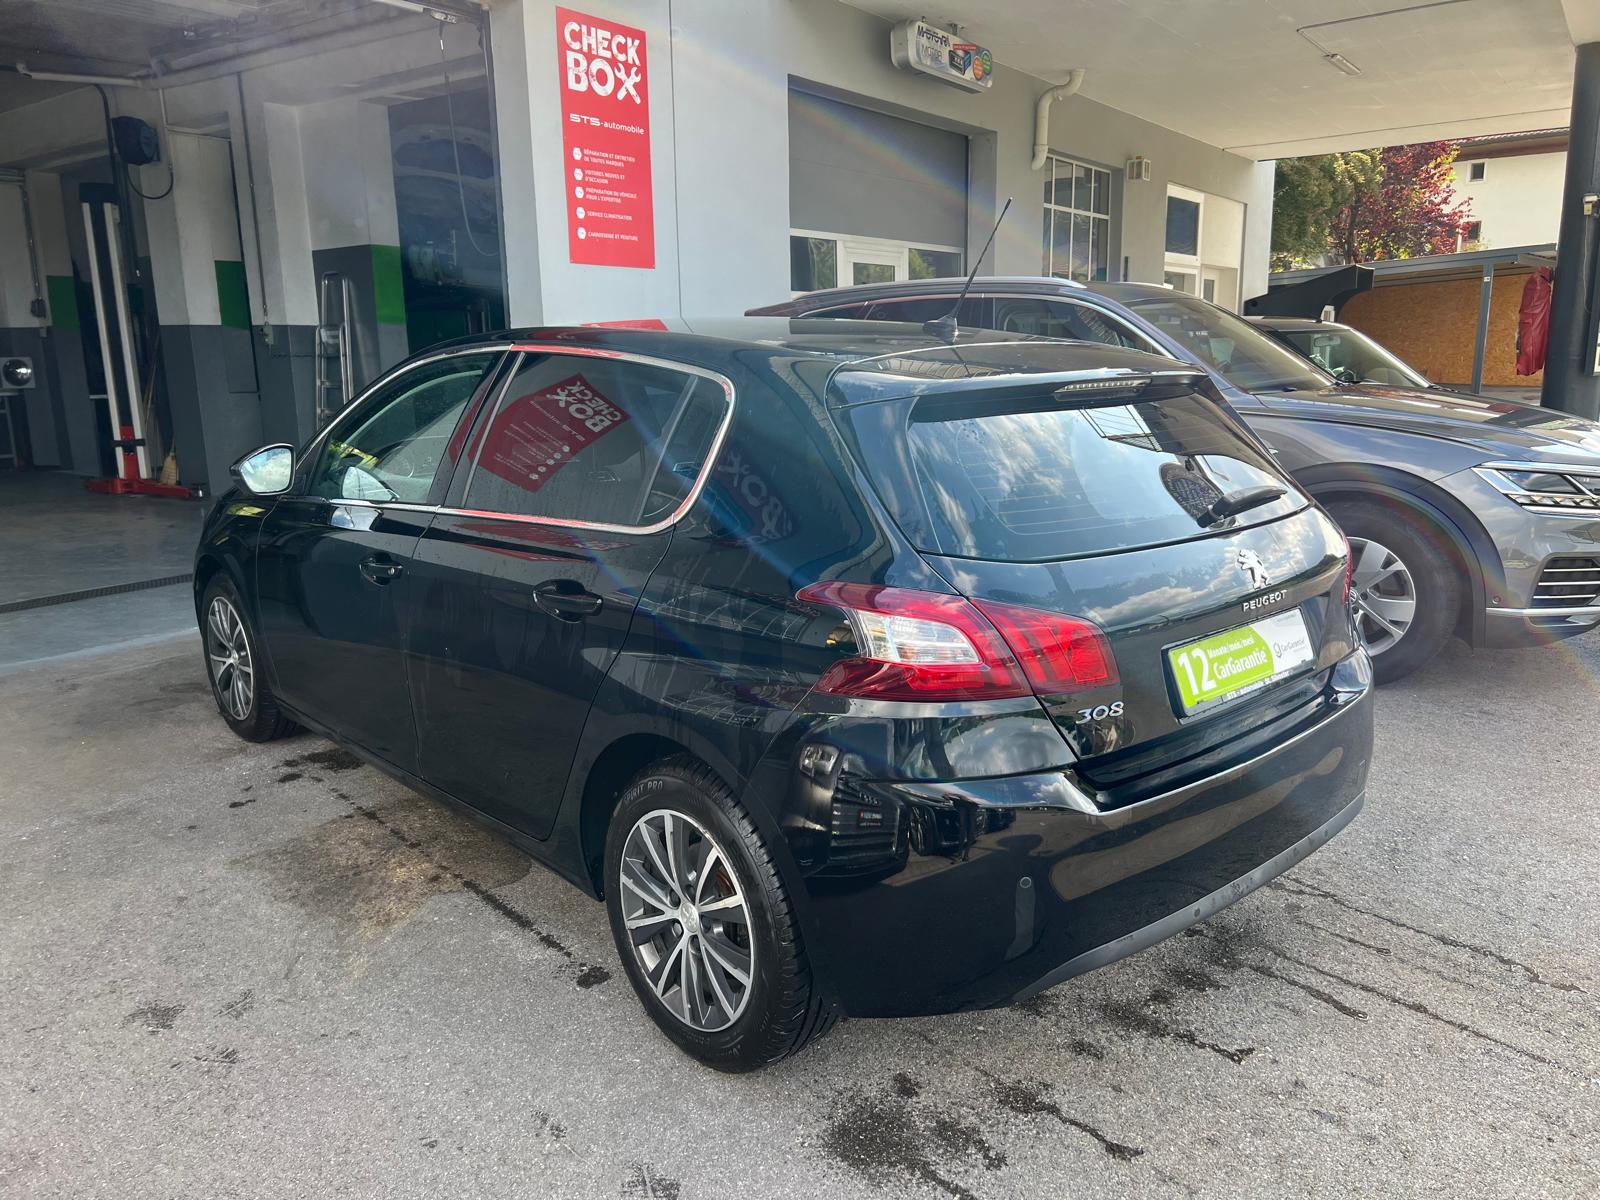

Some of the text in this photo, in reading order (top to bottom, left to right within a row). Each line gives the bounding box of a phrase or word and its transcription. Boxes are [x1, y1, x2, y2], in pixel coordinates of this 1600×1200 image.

[564, 21, 640, 66] CHECK
[566, 50, 641, 104] BOX
[1242, 590, 1288, 612] PEUGEOT
[1178, 648, 1216, 696] 12
[1213, 649, 1268, 680] CarGarantie
[1075, 701, 1124, 724] 308
[647, 780, 663, 792] PRO
